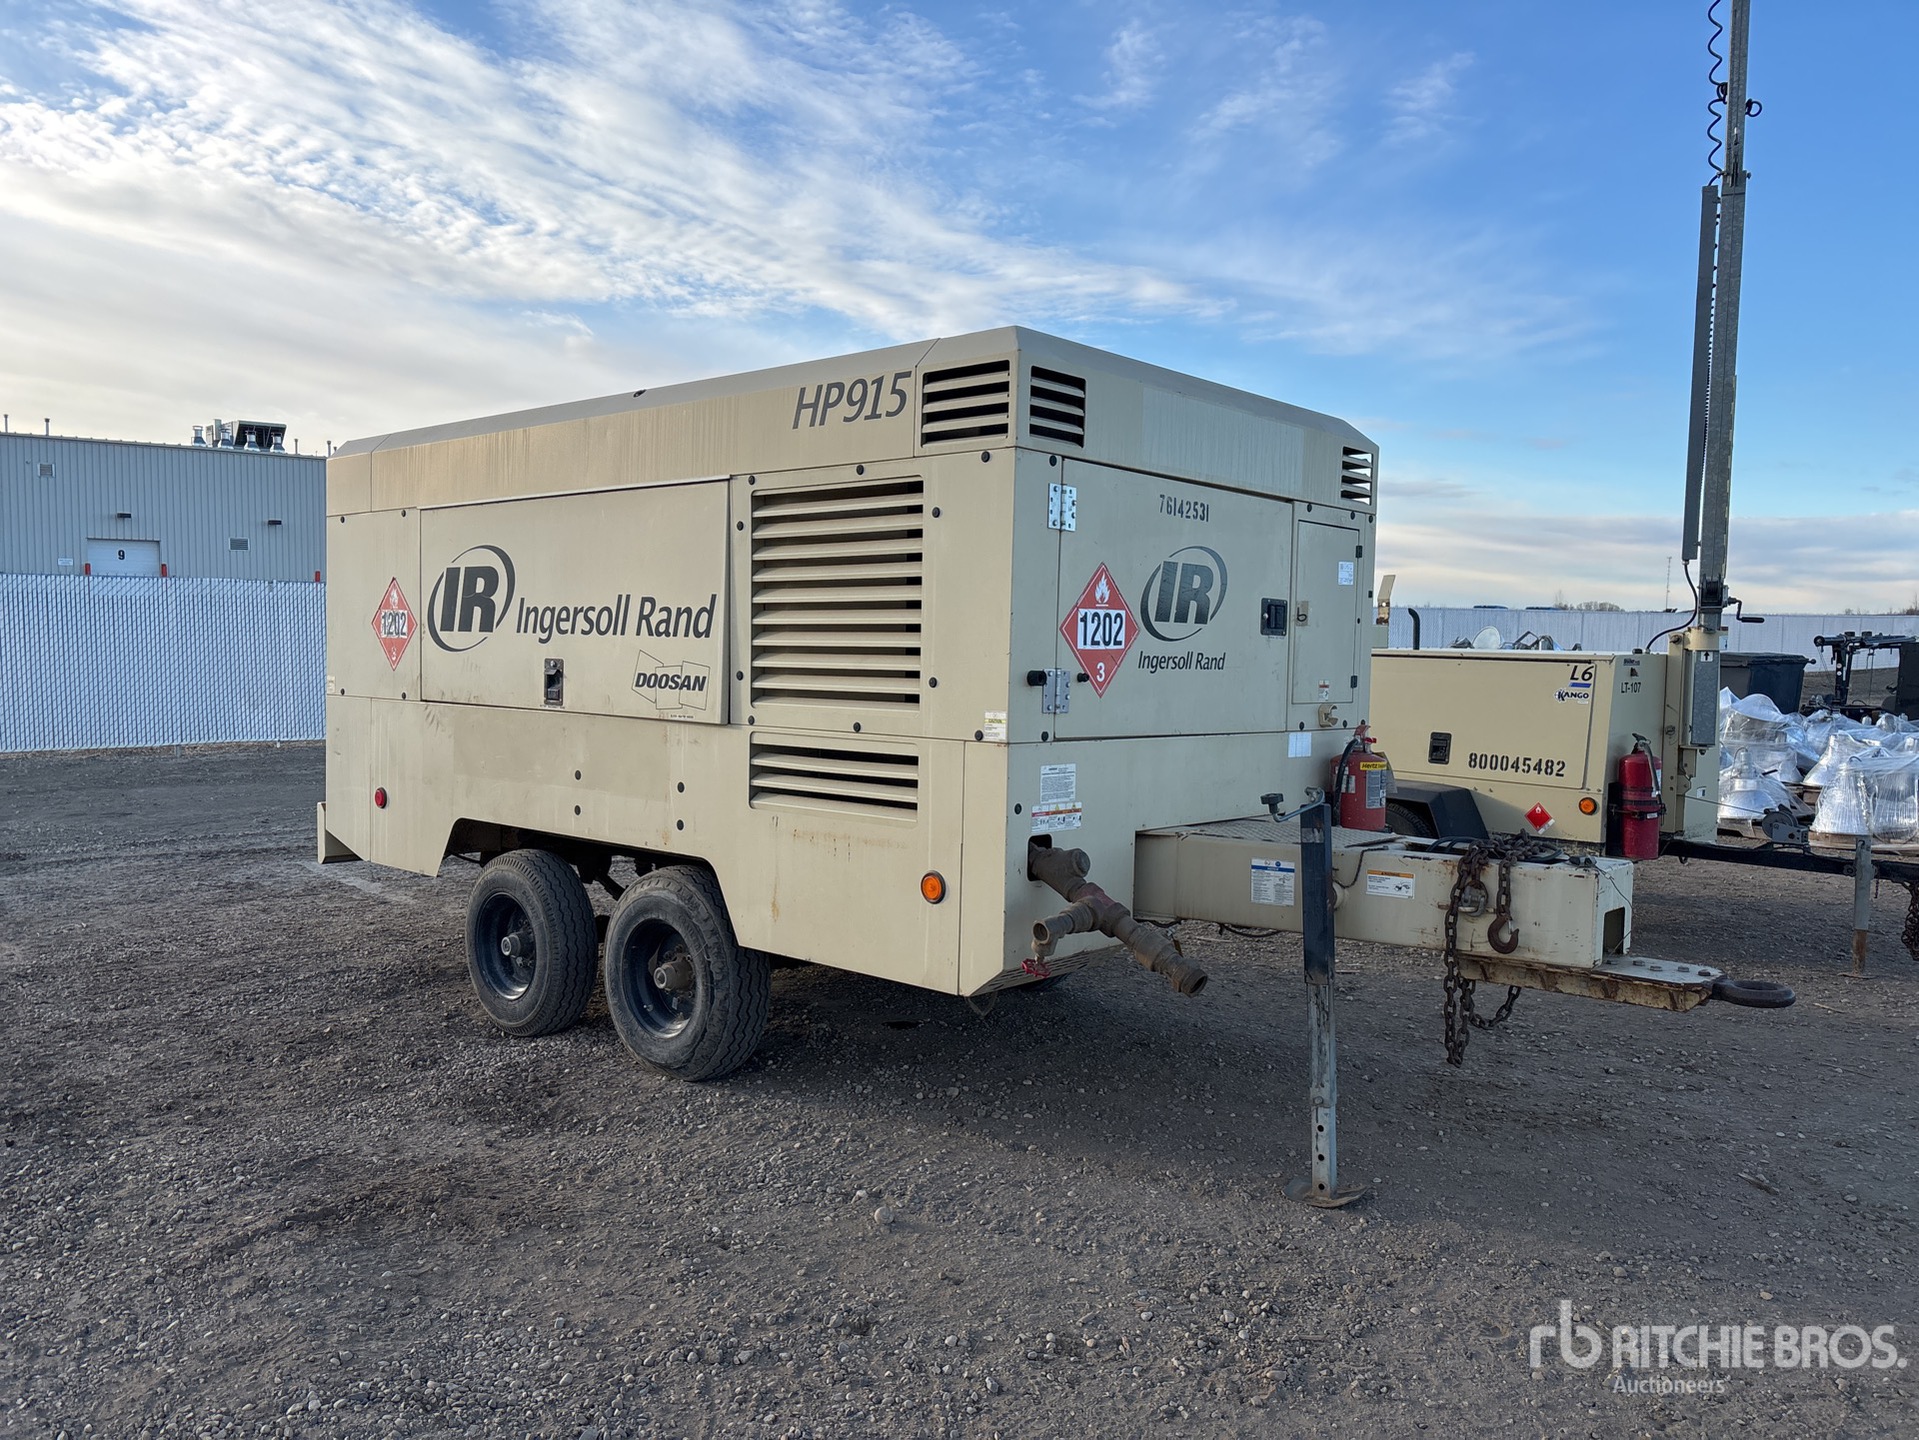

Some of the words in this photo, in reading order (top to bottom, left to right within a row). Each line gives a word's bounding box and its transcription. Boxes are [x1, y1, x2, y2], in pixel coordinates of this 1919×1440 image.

[792, 371, 912, 429] HP915
[1159, 494, 1210, 522] 76142531
[118, 549, 125, 560] 9
[439, 566, 500, 633] IR
[1154, 561, 1214, 625] IR
[381, 611, 407, 636] 1202
[516, 594, 631, 644] Ingersoll
[635, 594, 718, 639] Rand
[1080, 611, 1124, 647] 1202
[1096, 662, 1106, 682] 3
[1138, 651, 1194, 674] Ingersoll
[1195, 652, 1226, 671] Rand
[1570, 665, 1595, 681] L6
[635, 672, 707, 692] DOOSAN
[1621, 682, 1642, 694] LT-107
[1468, 752, 1566, 777] 800045482
